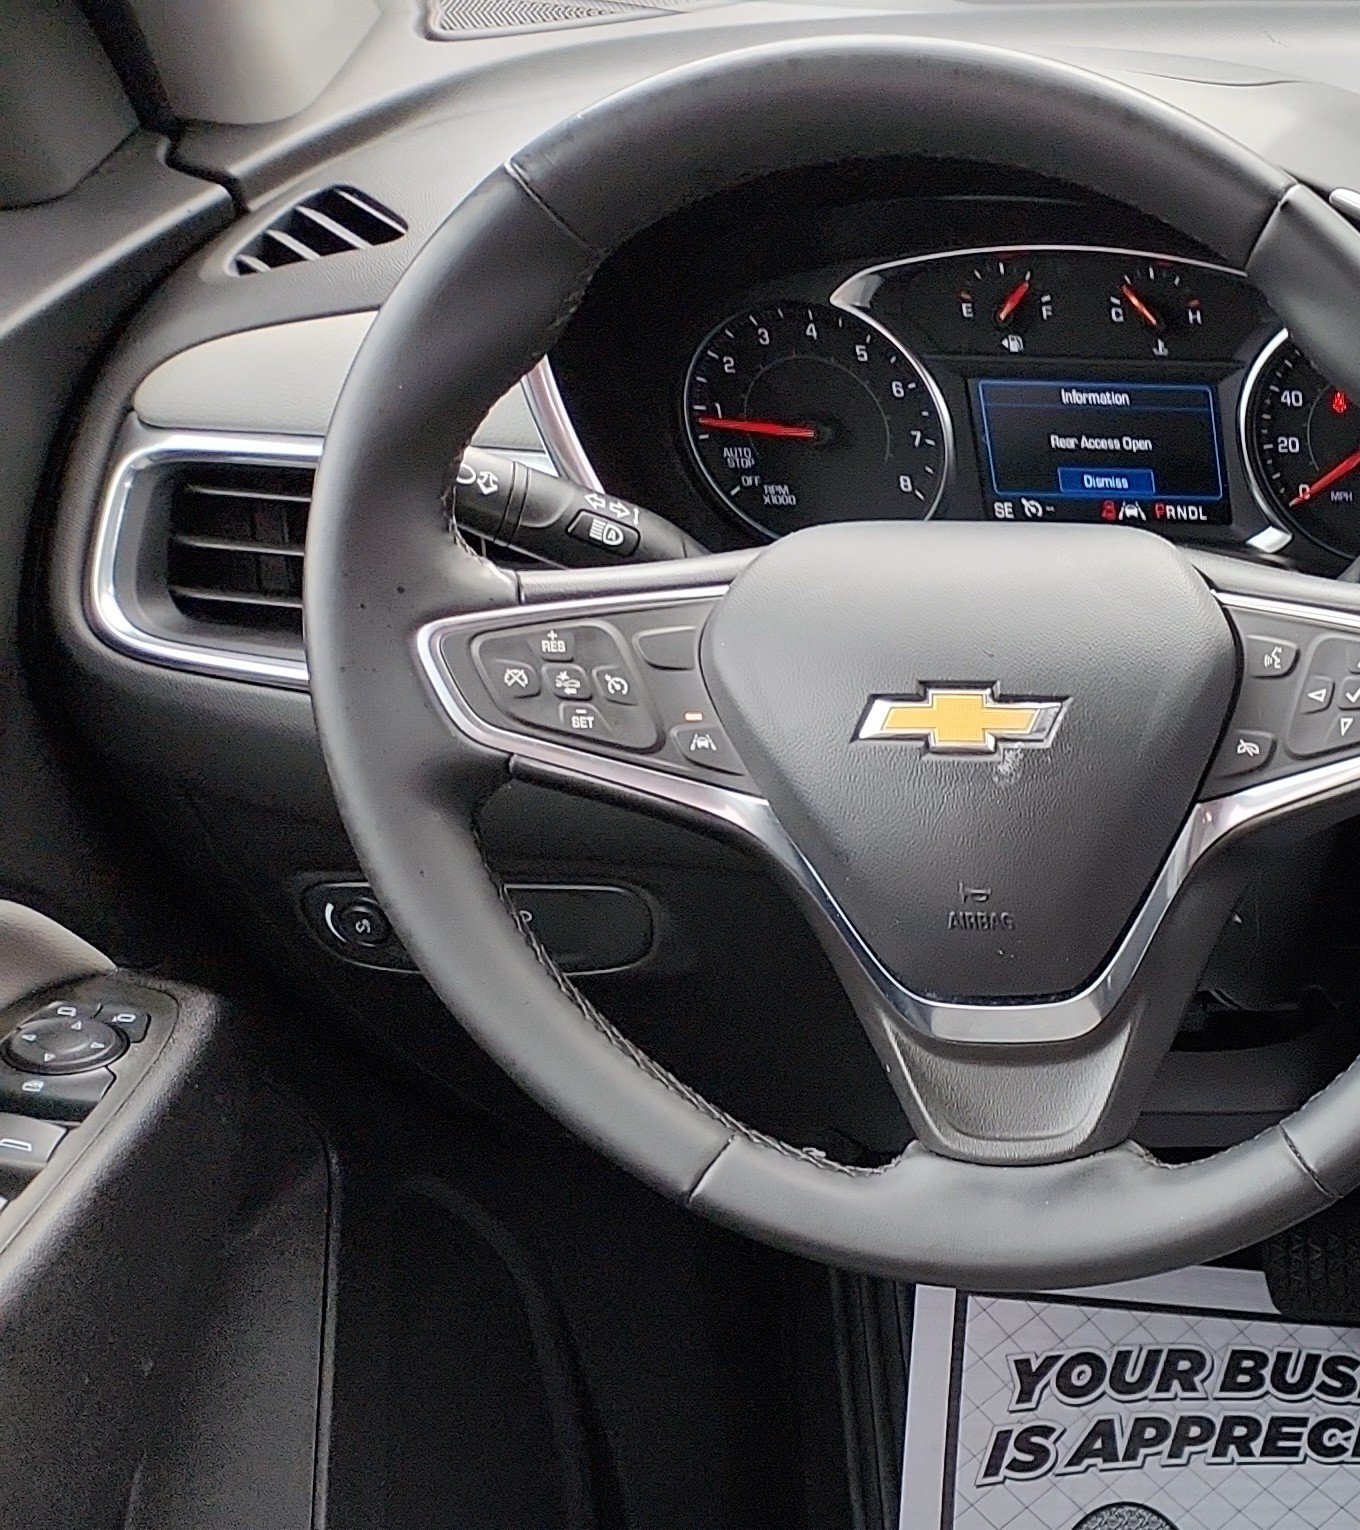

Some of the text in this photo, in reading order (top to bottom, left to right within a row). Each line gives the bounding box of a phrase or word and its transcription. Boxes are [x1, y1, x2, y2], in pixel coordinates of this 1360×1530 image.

[961, 303, 973, 318] E
[1042, 305, 1053, 321] F
[1189, 309, 1201, 325] H
[758, 328, 769, 345] 3
[806, 323, 818, 340] 4
[856, 345, 868, 362] 5
[723, 356, 736, 373] 2
[892, 381, 905, 397] 6
[1061, 389, 1130, 406] Information
[1281, 390, 1303, 407] 40
[715, 403, 722, 418] 1
[911, 431, 922, 447] 7
[1051, 435, 1152, 452] Rear Access Open
[1278, 437, 1299, 453] 20
[723, 447, 751, 458] AUTO
[727, 457, 755, 468] STOP
[741, 475, 760, 486] OFF
[900, 476, 911, 492] 8
[1084, 474, 1128, 489] Dismiss
[764, 485, 789, 495] RPM
[1299, 484, 1310, 499] 0
[1331, 491, 1353, 502] MPH
[994, 502, 1014, 519] SE
[542, 640, 566, 652] RES
[572, 716, 594, 729] SET
[948, 911, 1014, 931] AIRBAG
[1007, 1345, 1211, 1411] YOUR
[979, 1420, 1064, 1486] IS
